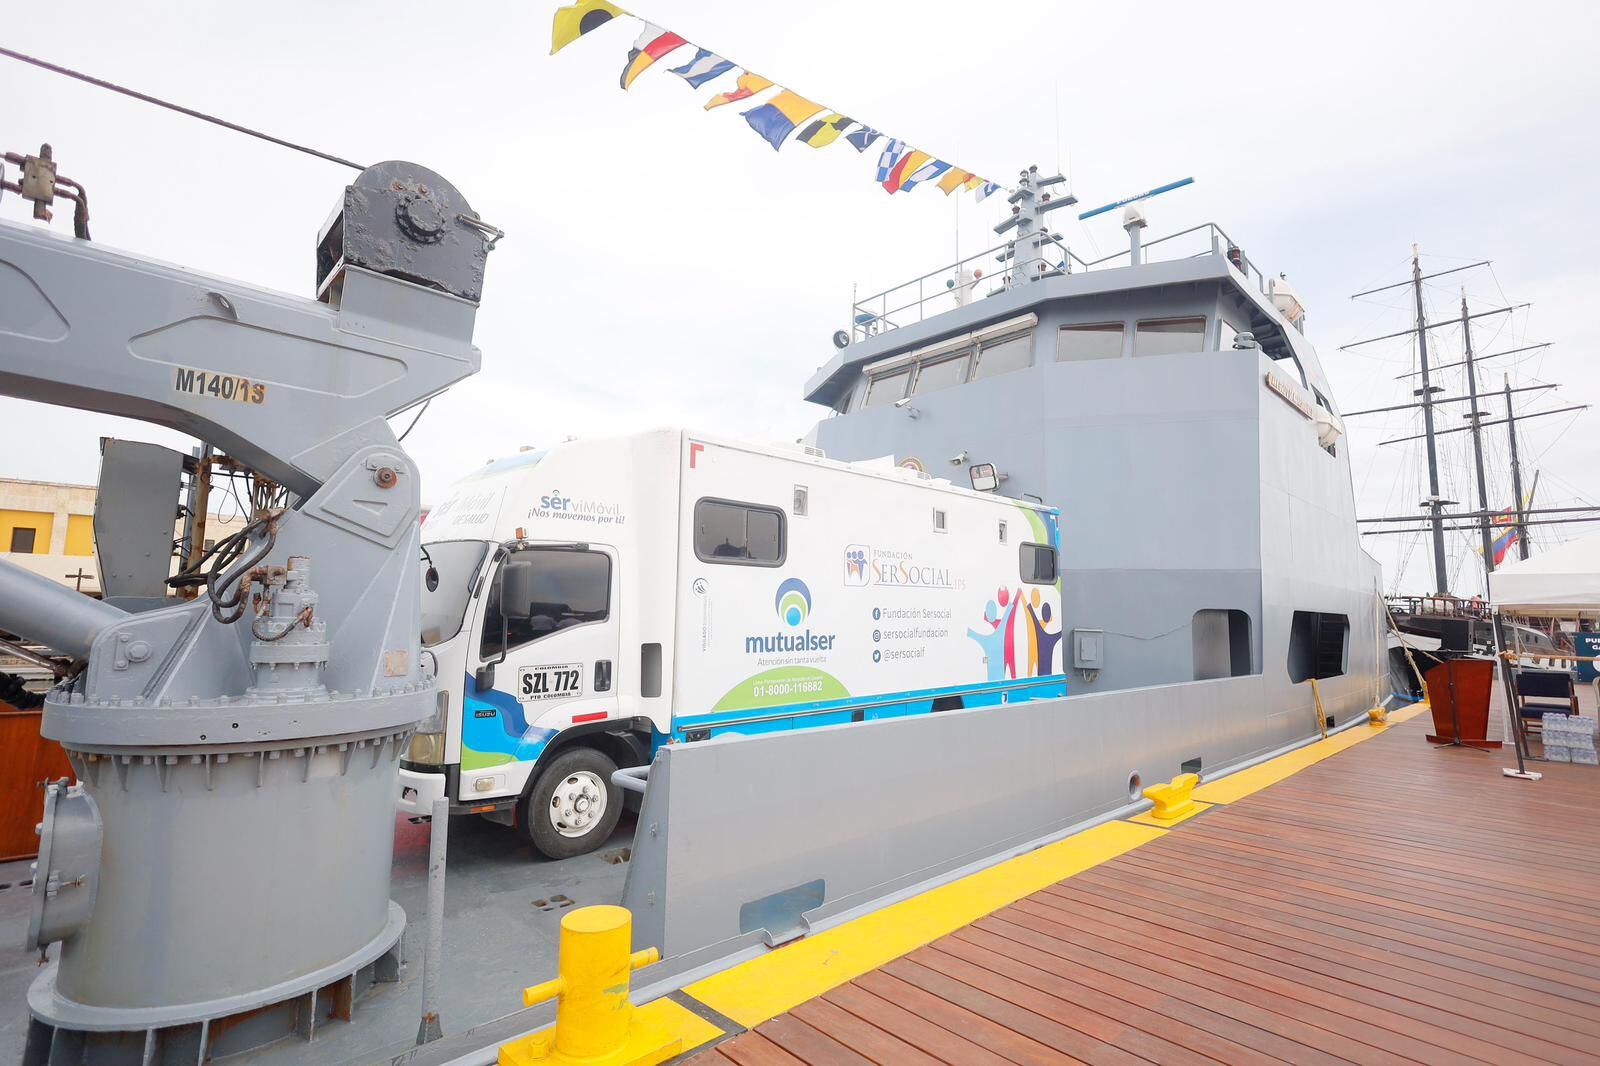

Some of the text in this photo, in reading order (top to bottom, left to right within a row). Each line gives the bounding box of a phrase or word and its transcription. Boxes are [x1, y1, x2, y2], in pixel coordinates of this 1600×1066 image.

[528, 507, 550, 519] ¡Nos
[552, 511, 595, 522] movemos
[597, 515, 614, 525] por
[883, 607, 952, 619] Fundación Sersocial
[745, 629, 836, 654] mutualser
[757, 656, 785, 666] Atención
[522, 670, 580, 695] SZL 772
